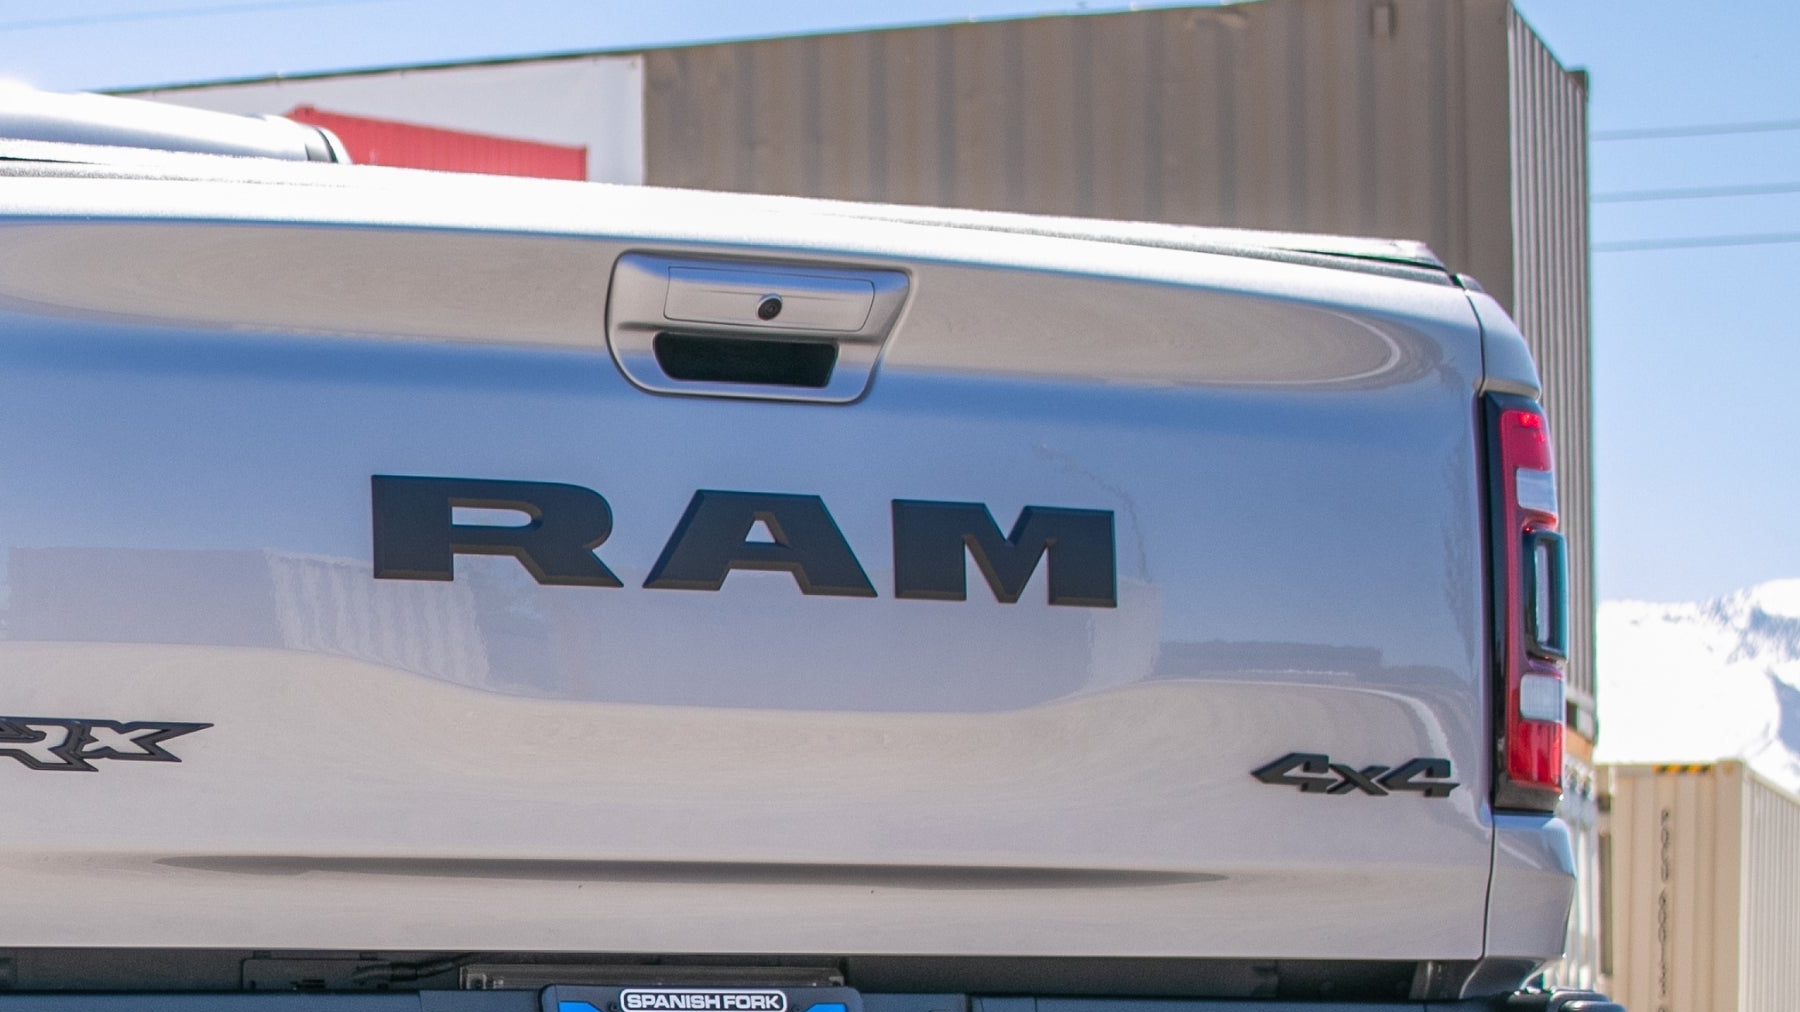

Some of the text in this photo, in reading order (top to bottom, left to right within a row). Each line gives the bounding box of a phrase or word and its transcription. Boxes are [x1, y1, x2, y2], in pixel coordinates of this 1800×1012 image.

[371, 474, 1118, 608] RAM
[626, 993, 781, 1010] SPANISH FORK
